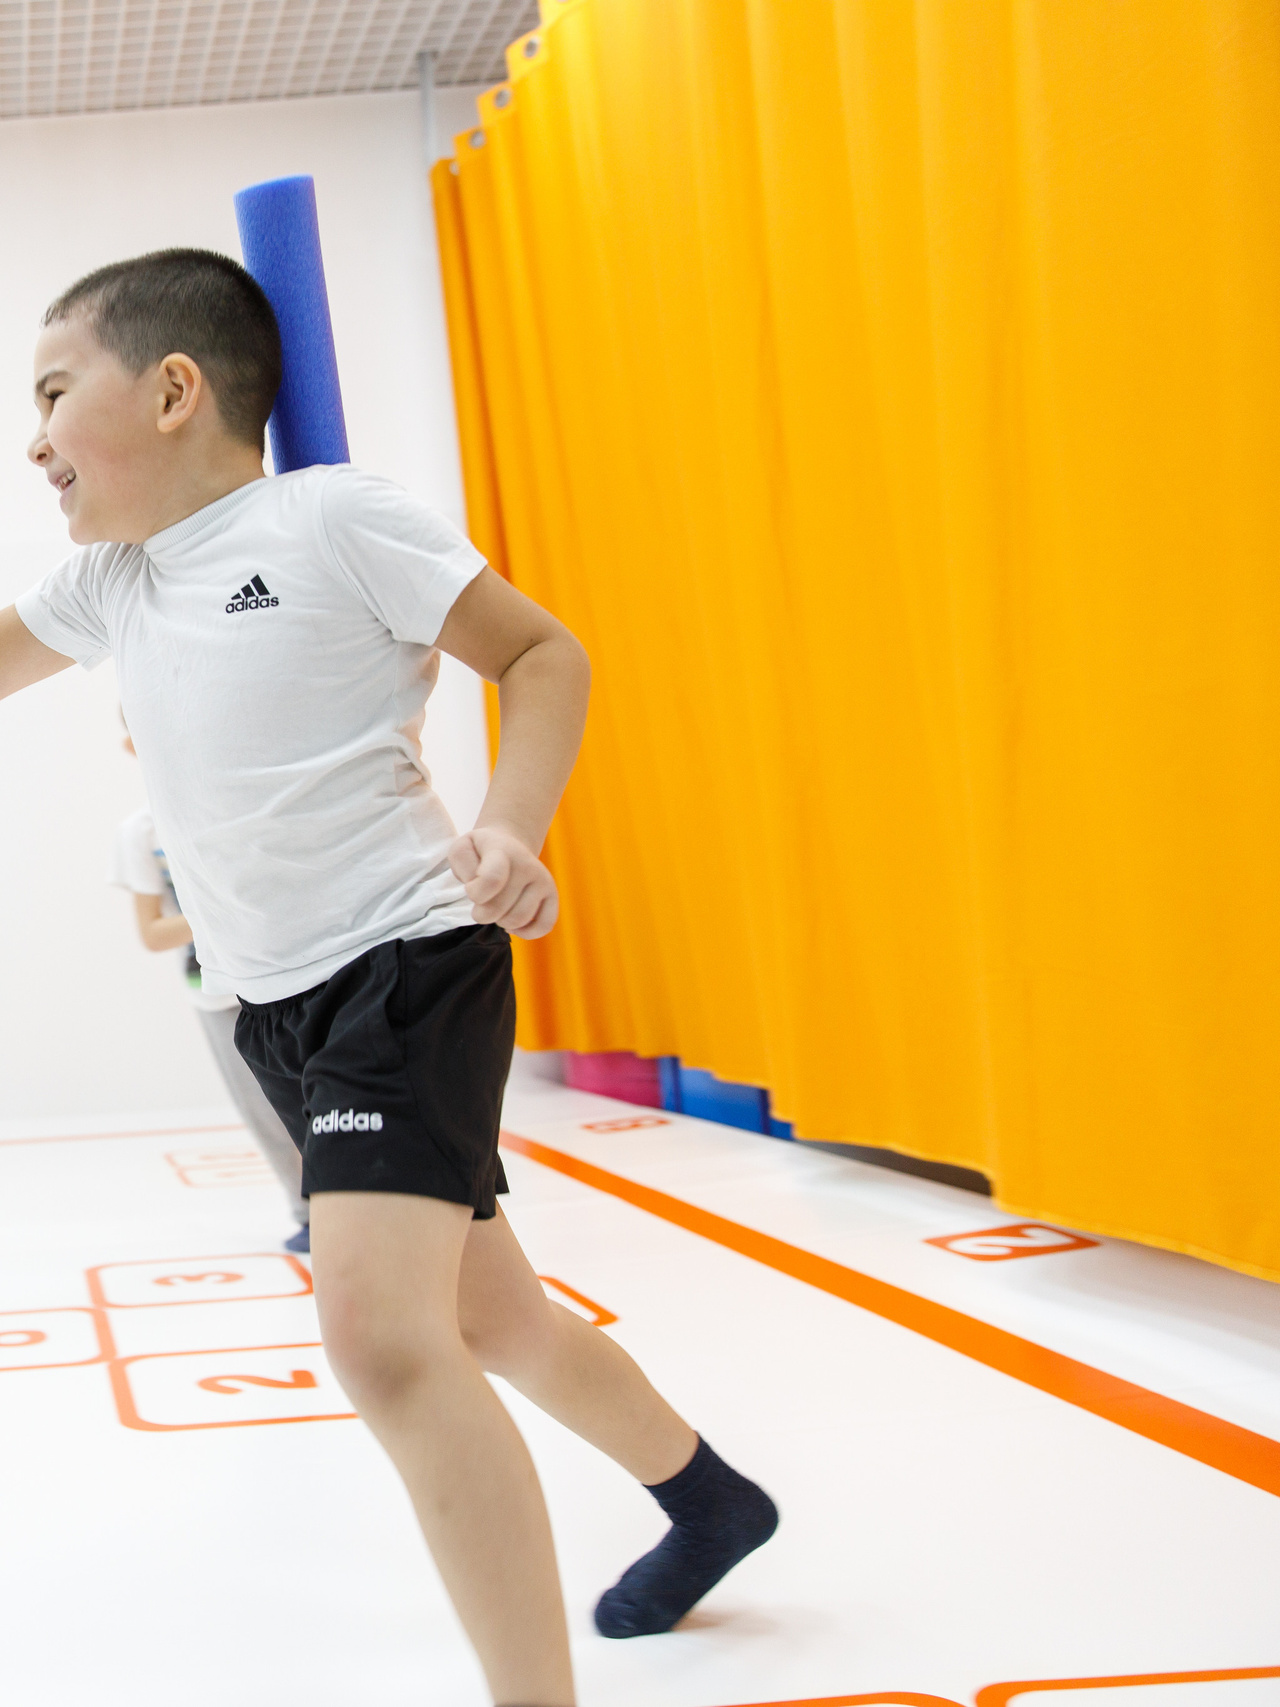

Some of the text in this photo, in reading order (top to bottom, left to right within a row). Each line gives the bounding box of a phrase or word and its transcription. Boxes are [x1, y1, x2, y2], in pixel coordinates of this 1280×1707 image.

[225, 595, 280, 614] adidas
[312, 1108, 384, 1135] adidas
[151, 1271, 245, 1287] 3
[196, 1369, 320, 1396] 2
